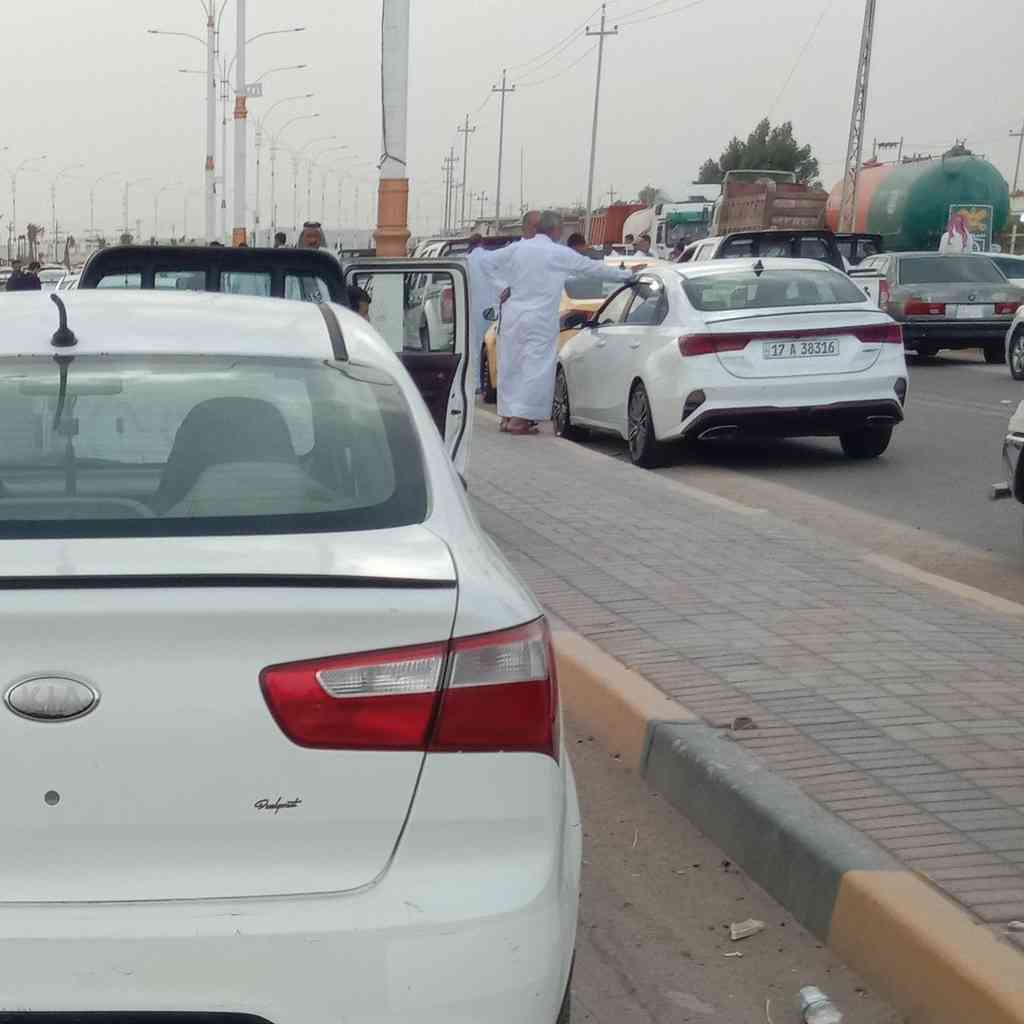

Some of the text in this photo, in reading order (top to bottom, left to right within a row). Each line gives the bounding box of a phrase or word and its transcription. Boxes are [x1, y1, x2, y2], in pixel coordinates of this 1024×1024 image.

[771, 341, 835, 357] 17 A 38316
[20, 685, 82, 712] KIA
